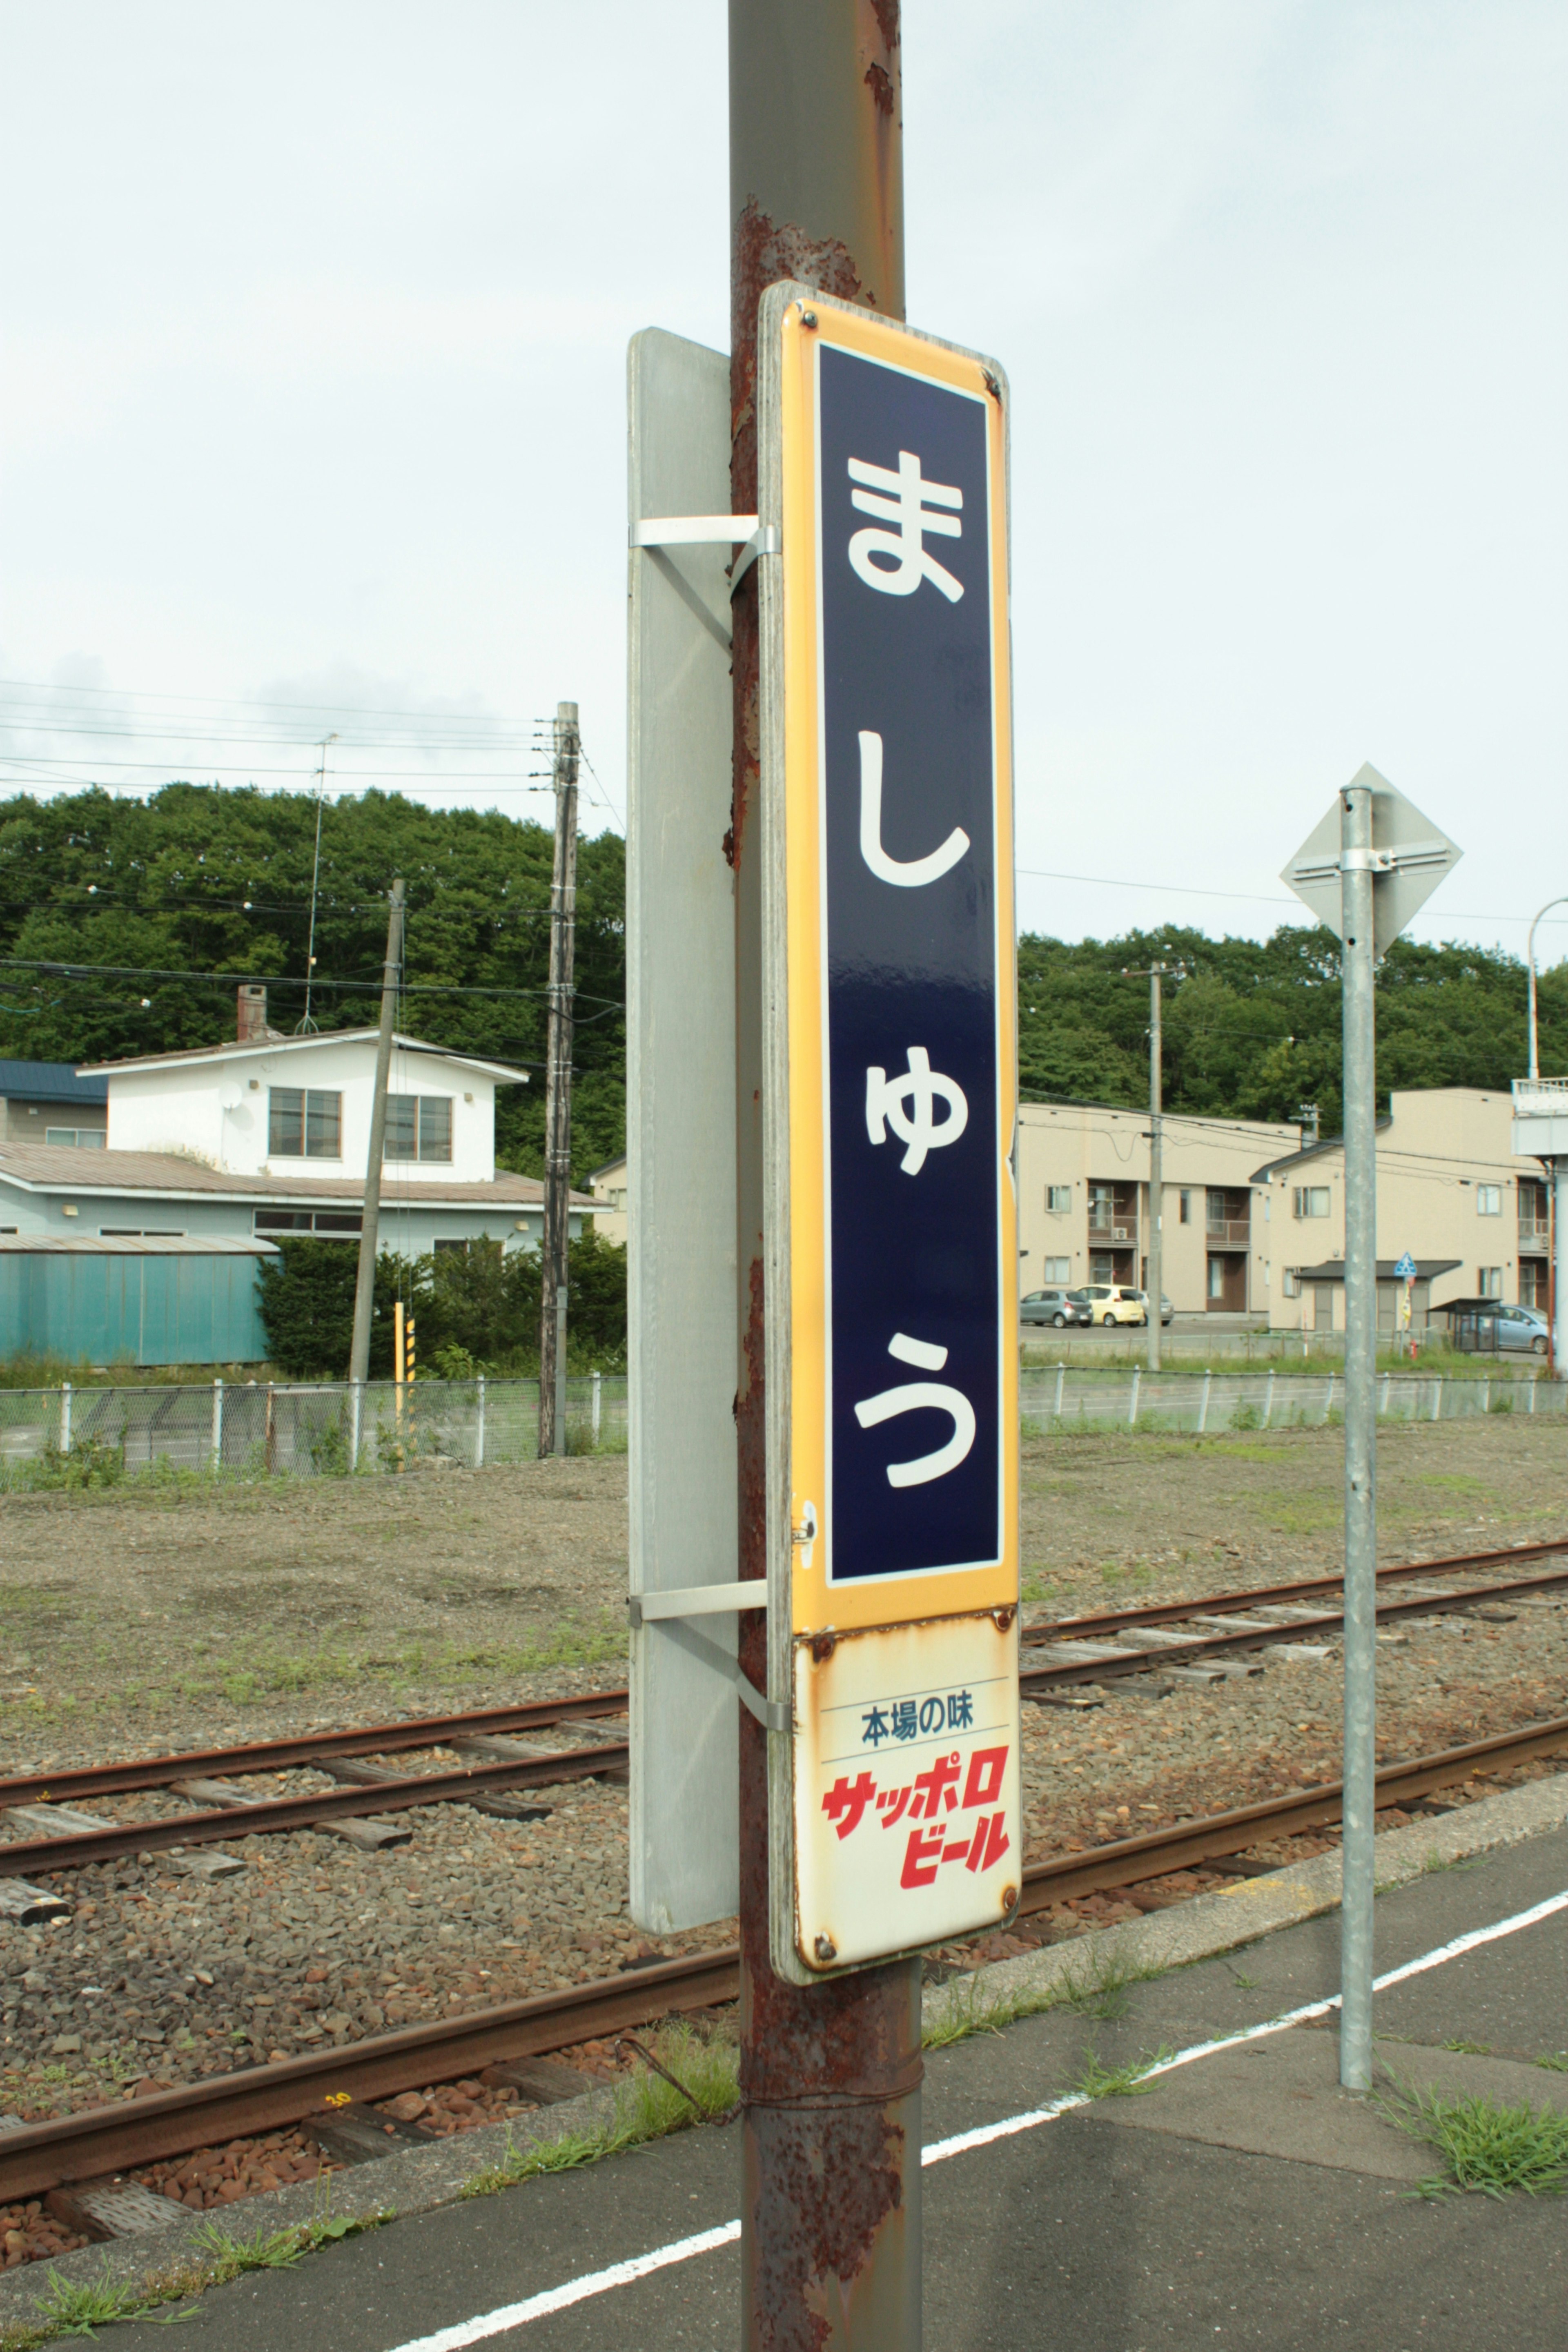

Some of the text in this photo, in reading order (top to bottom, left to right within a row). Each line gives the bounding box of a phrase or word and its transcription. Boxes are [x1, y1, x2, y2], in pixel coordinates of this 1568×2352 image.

[847, 450, 976, 1487] ましゅう
[862, 1690, 973, 1746] 本場の味
[822, 1746, 1009, 1840] サッポロ
[900, 1811, 1010, 1889] ビール
